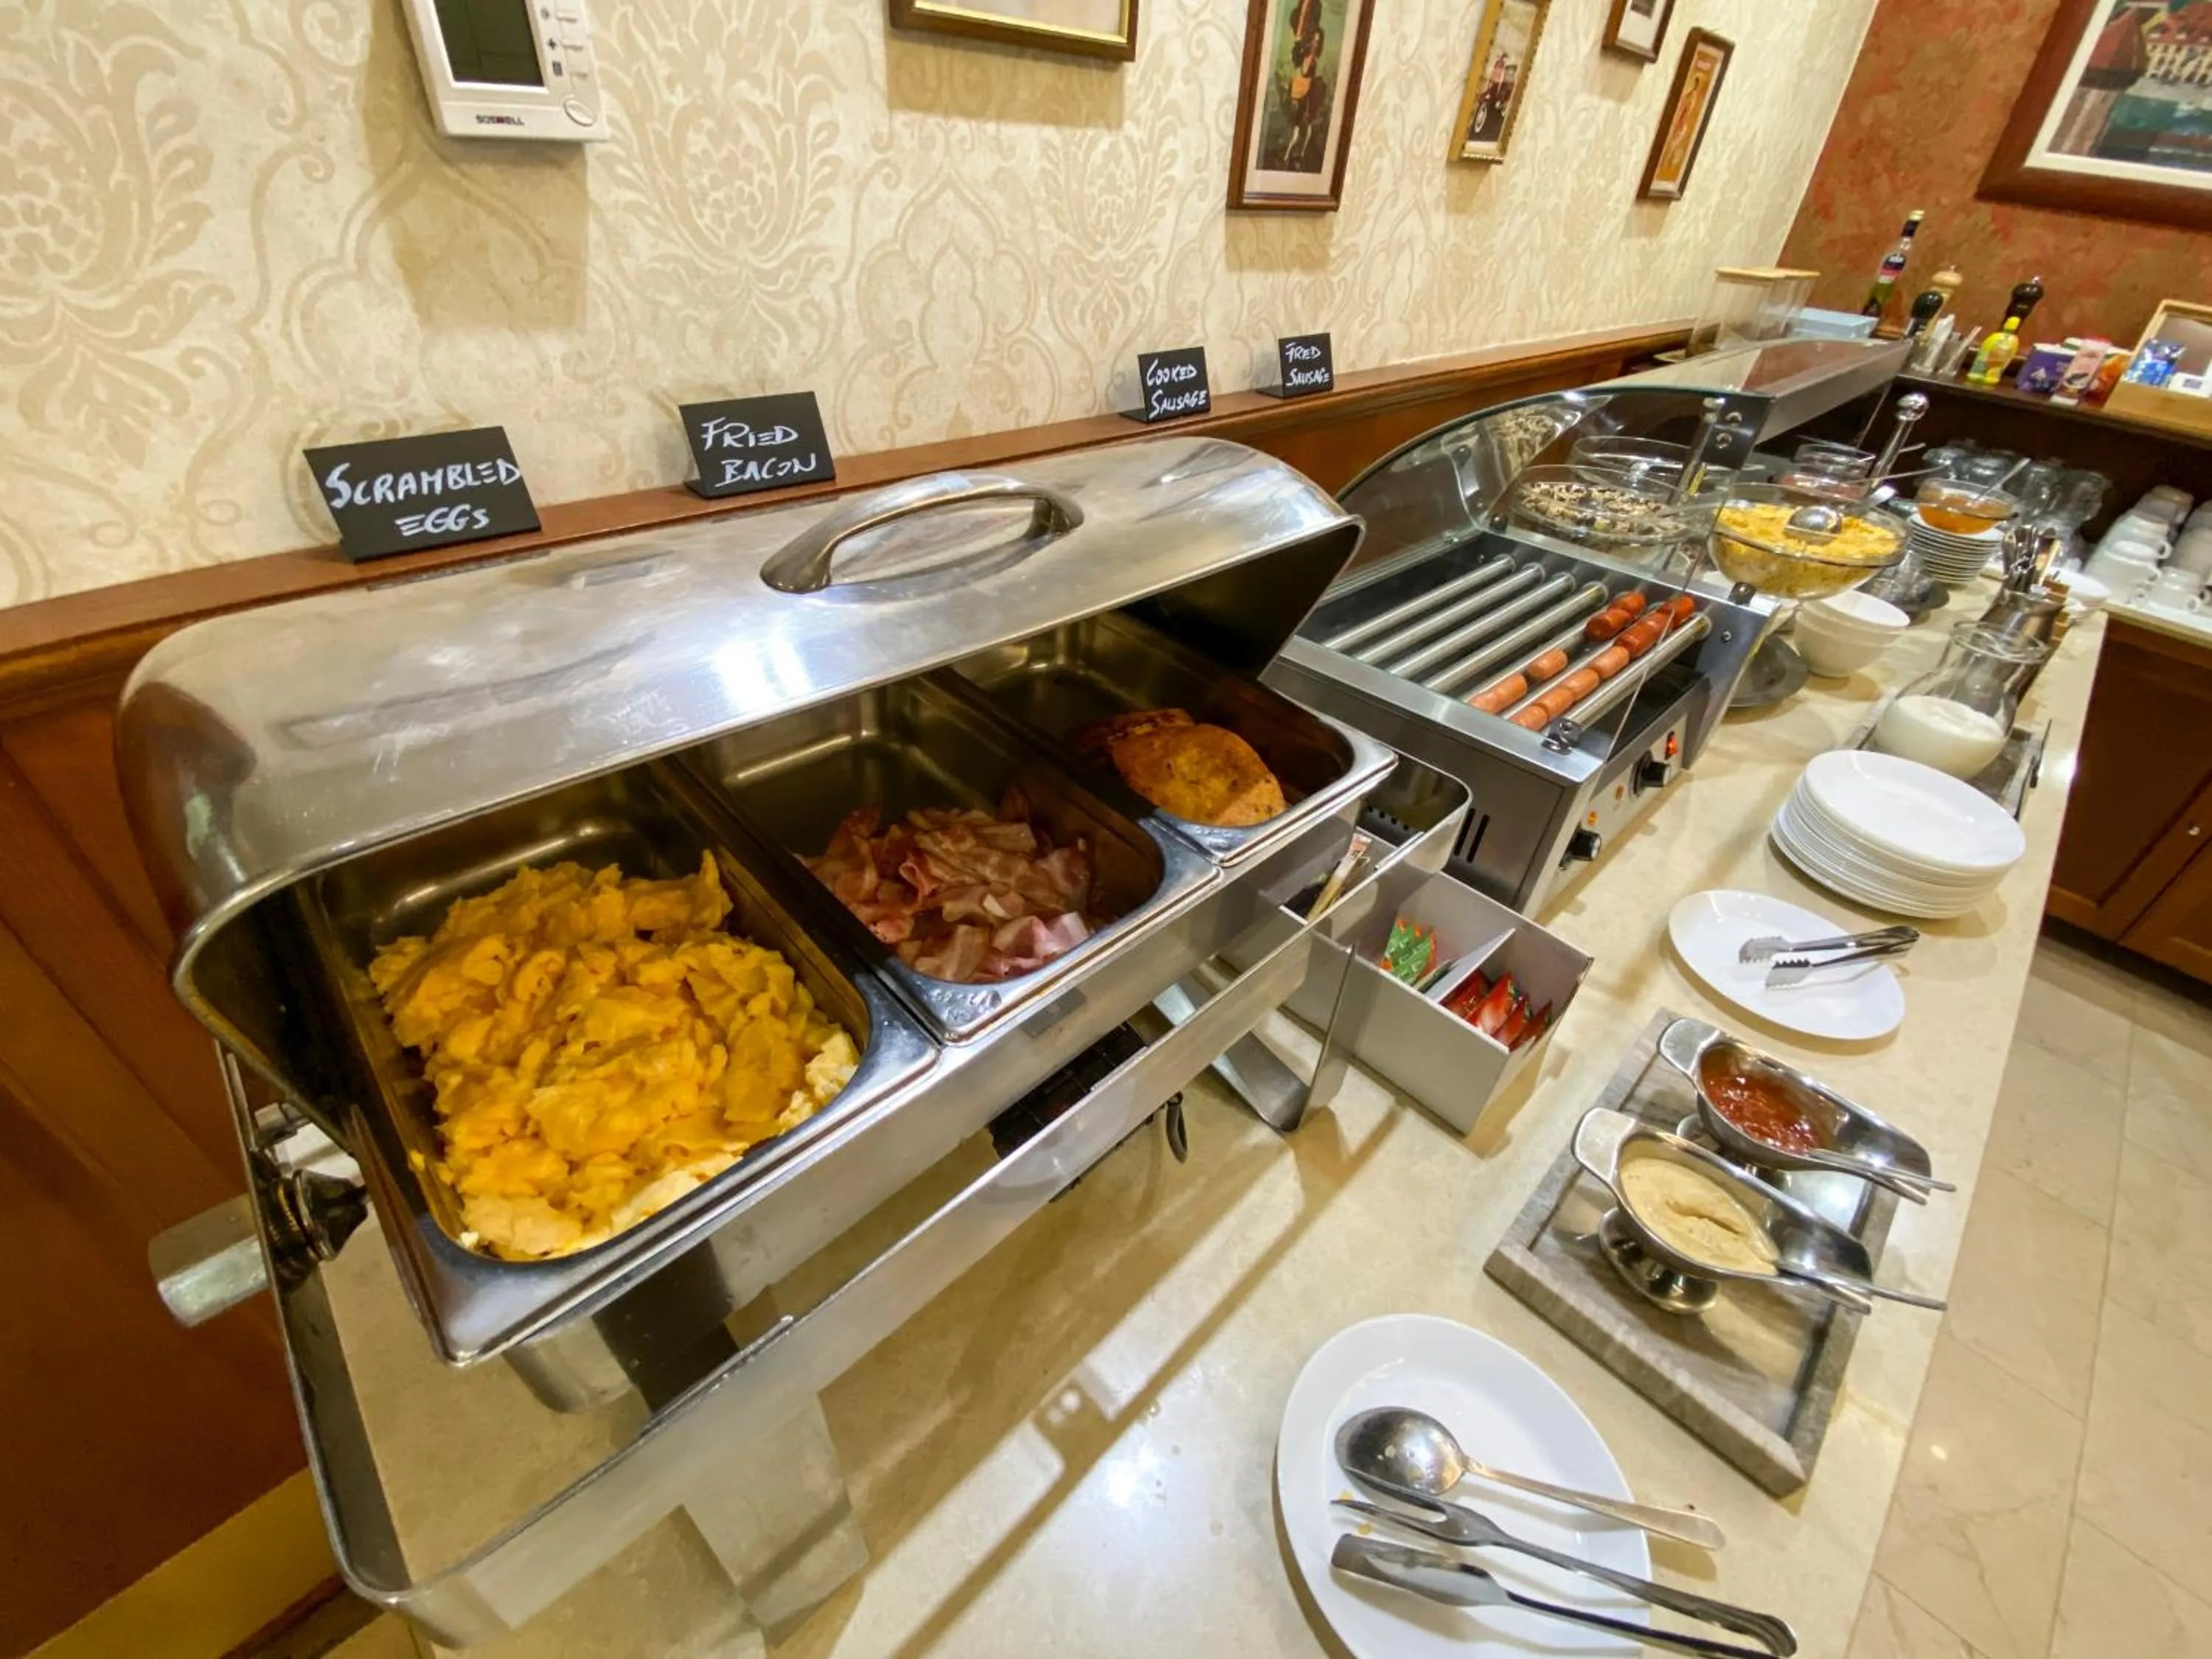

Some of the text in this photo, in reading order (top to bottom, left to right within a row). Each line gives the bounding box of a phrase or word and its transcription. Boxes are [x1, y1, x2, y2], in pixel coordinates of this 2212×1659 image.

[1147, 358, 1197, 386] COOKED
[1285, 366, 1330, 386] SAUSAGE
[1148, 389, 1208, 420] SAUSAGE
[701, 416, 799, 451] FRIED
[324, 458, 522, 509] SCRAMBLED
[714, 452, 816, 487] BACON
[394, 503, 490, 537] EGGS
